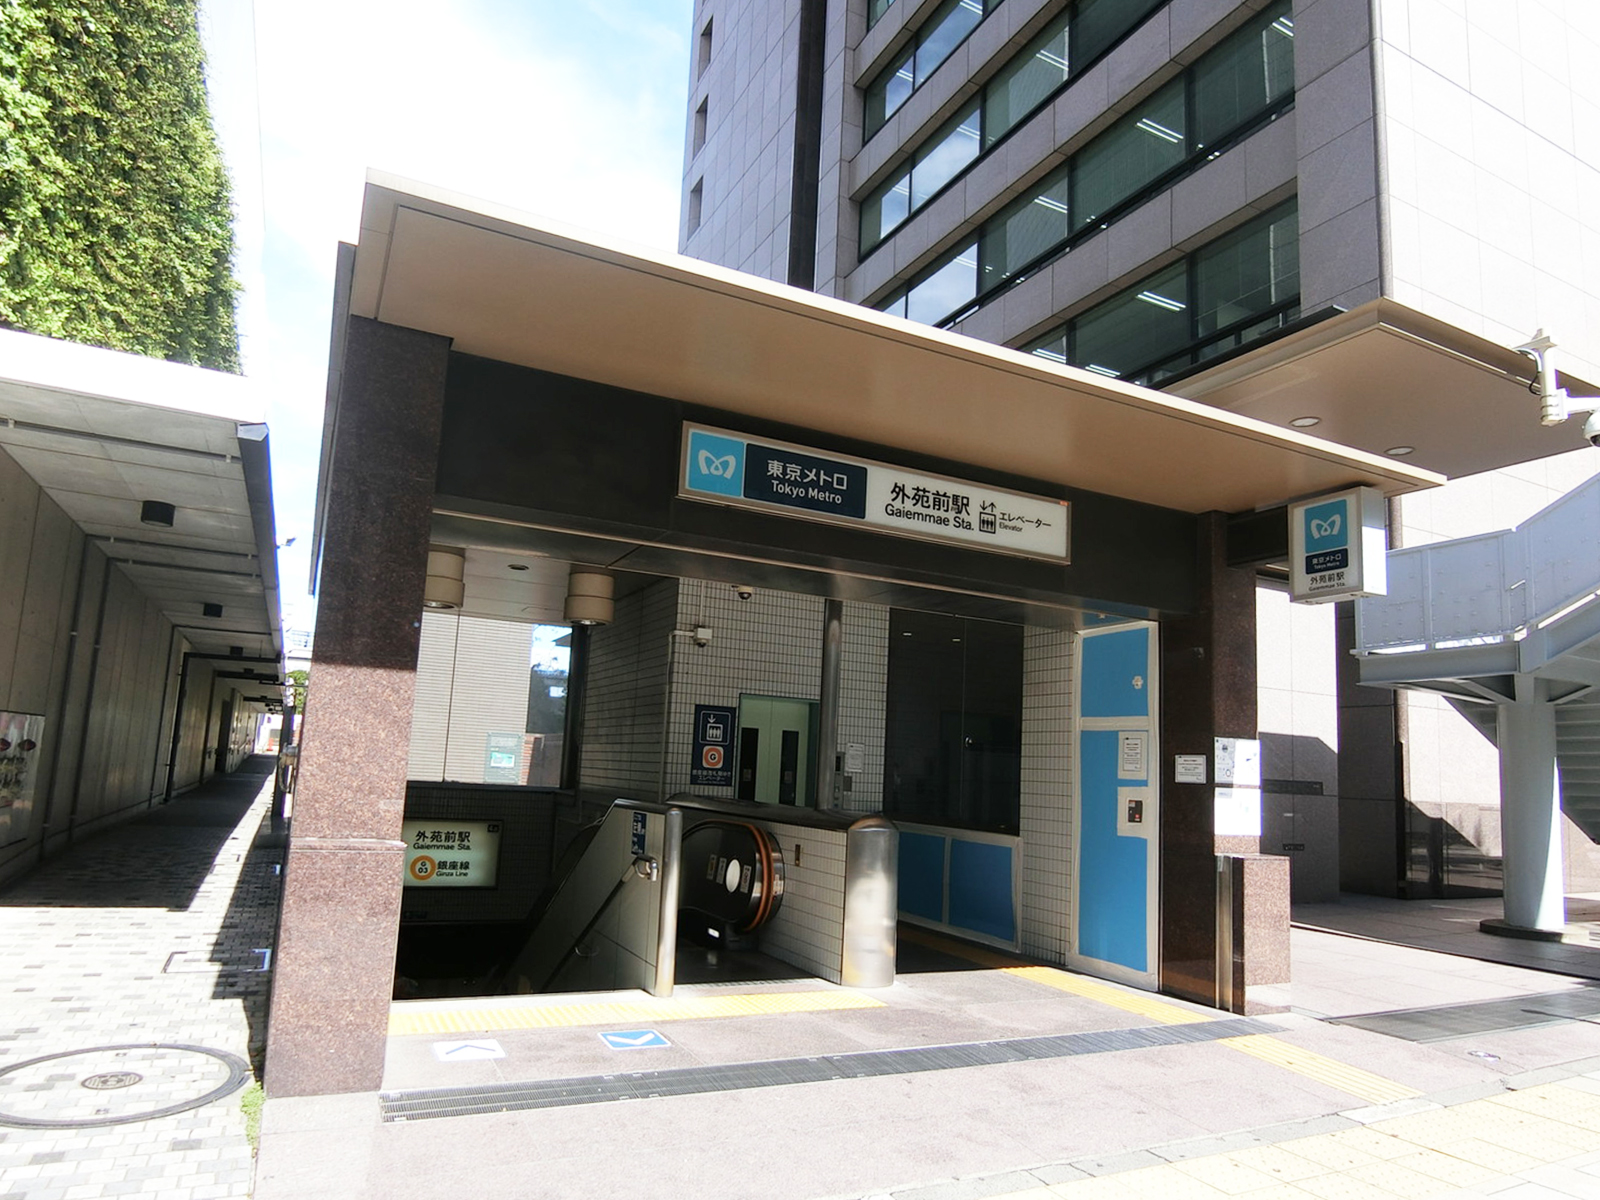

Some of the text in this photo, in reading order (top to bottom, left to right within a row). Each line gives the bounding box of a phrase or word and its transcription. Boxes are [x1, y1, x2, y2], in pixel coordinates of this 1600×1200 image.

[767, 460, 847, 490] 東京メトロ
[771, 480, 842, 504] Tokyo Metro
[890, 482, 970, 516] 外苑前駅
[885, 503, 974, 531] Gaiemmae Sta.
[999, 512, 1051, 528] エレベーター
[999, 522, 1023, 532] Elevator
[1310, 572, 1345, 585] 外苑前駅
[416, 831, 471, 842] 外苑前駅
